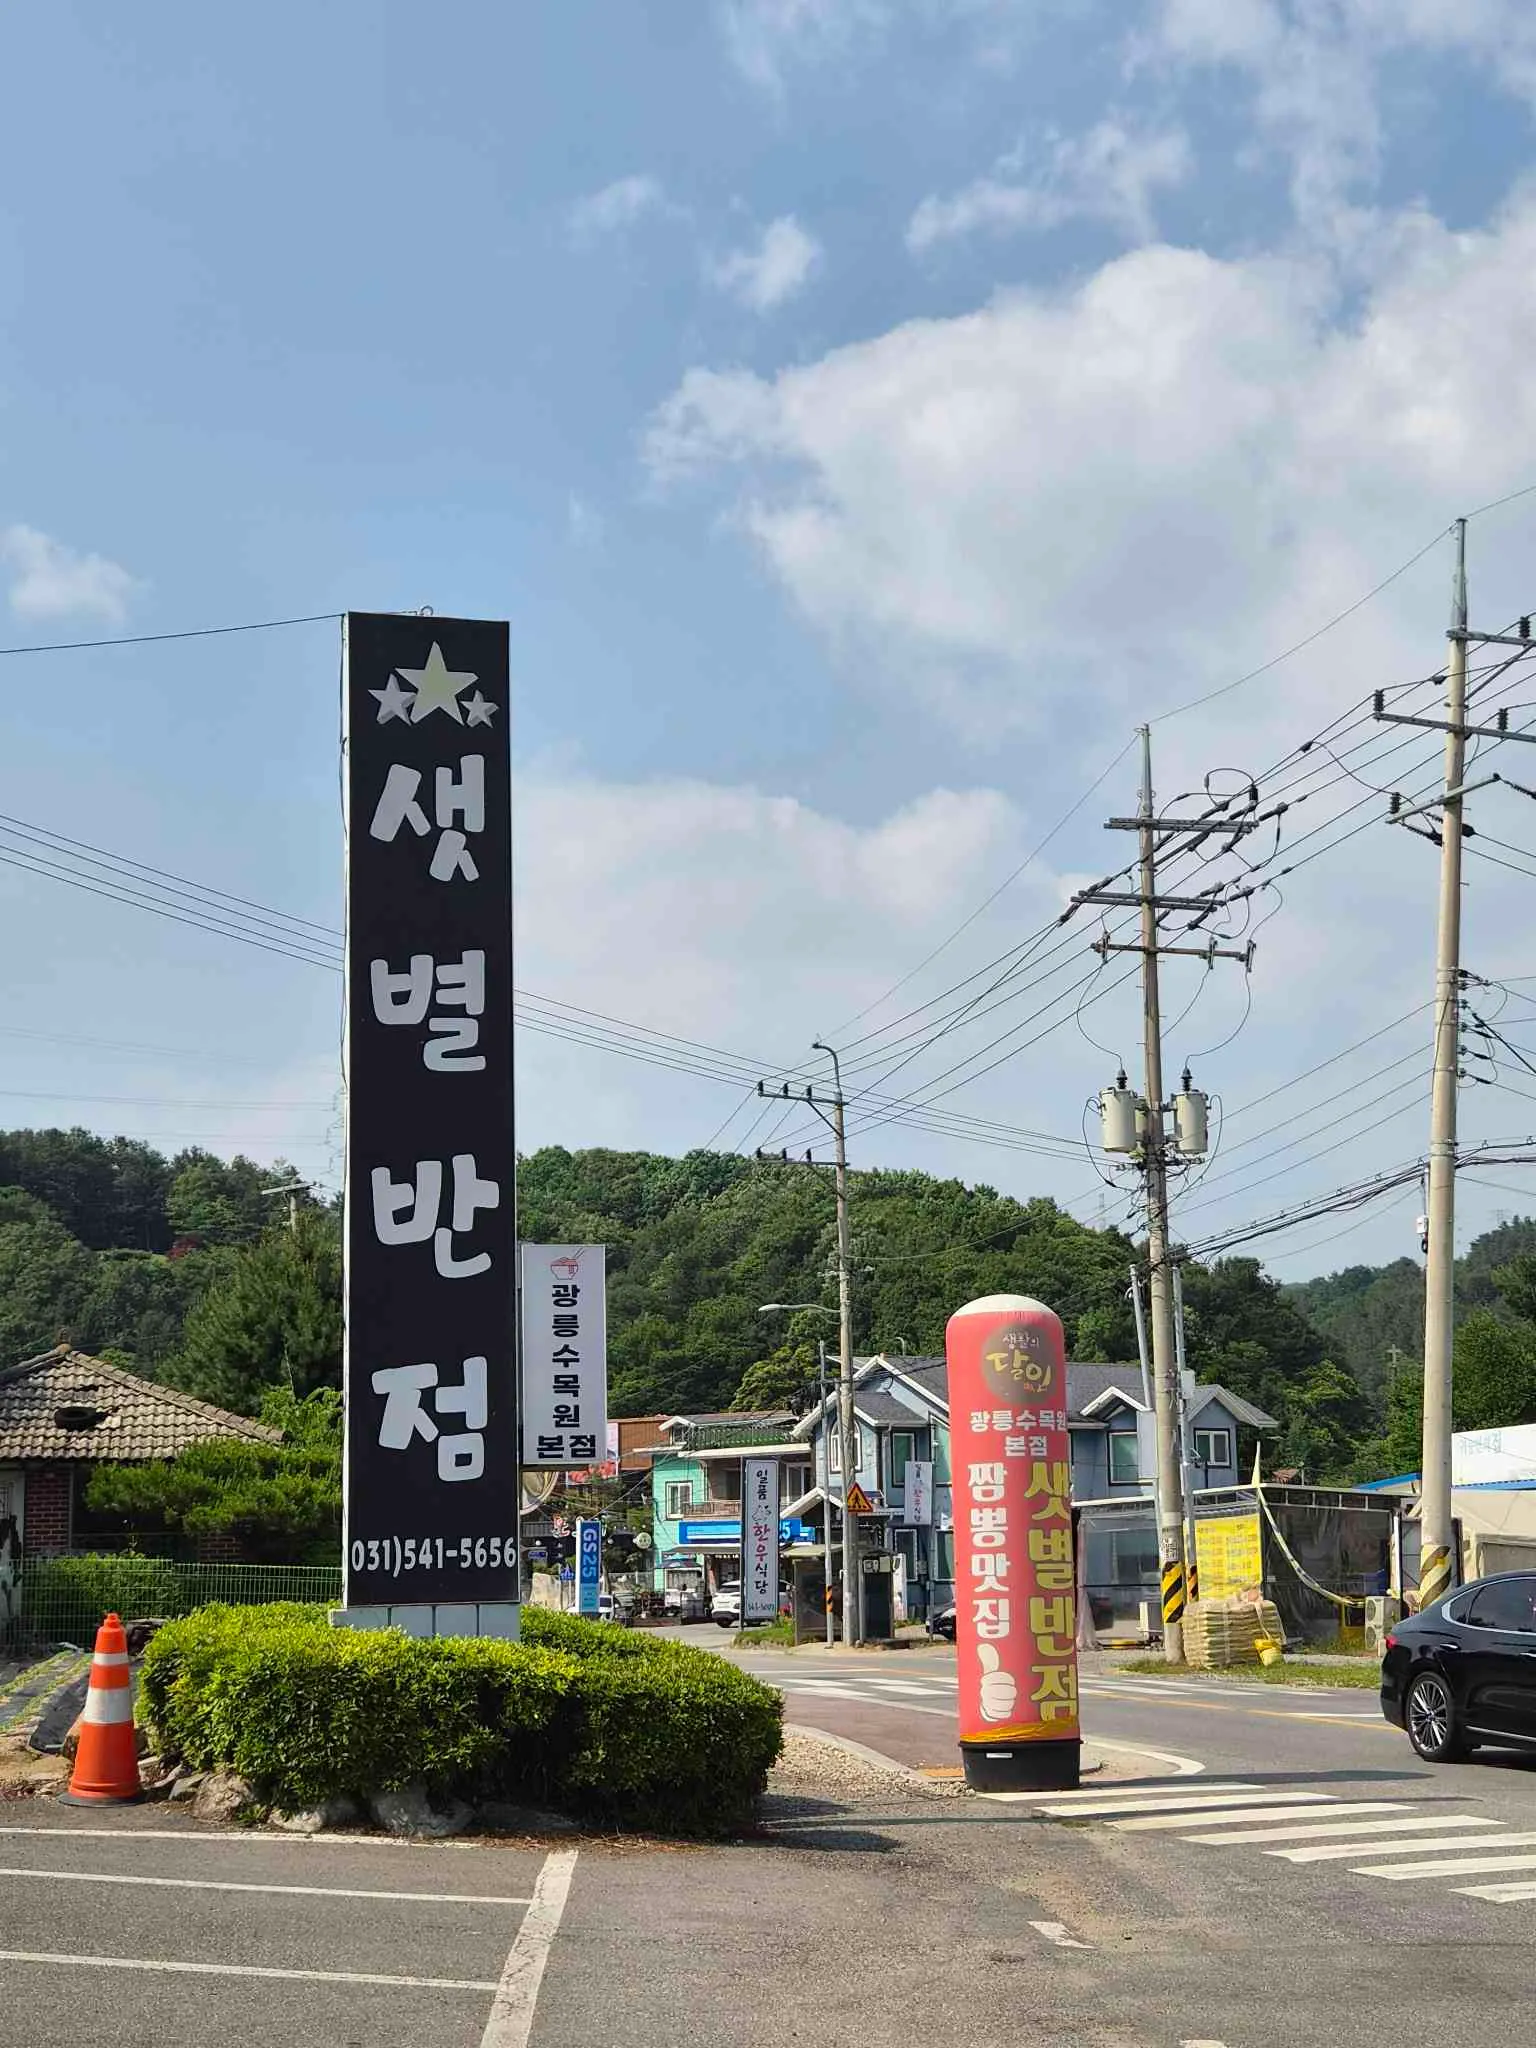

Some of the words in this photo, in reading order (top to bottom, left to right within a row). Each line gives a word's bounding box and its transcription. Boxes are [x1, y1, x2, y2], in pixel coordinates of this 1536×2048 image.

[368, 754, 499, 1484] 샛별반점
[551, 1284, 581, 1428] 광릉수목원
[970, 1409, 1067, 1432] 광릉수목원
[536, 1434, 596, 1459] 본점
[1005, 1435, 1048, 1456] 본점
[351, 1535, 517, 1577] 031)541-5656
[583, 1528, 598, 1578] GS25
[752, 1523, 770, 1594] 한우식당
